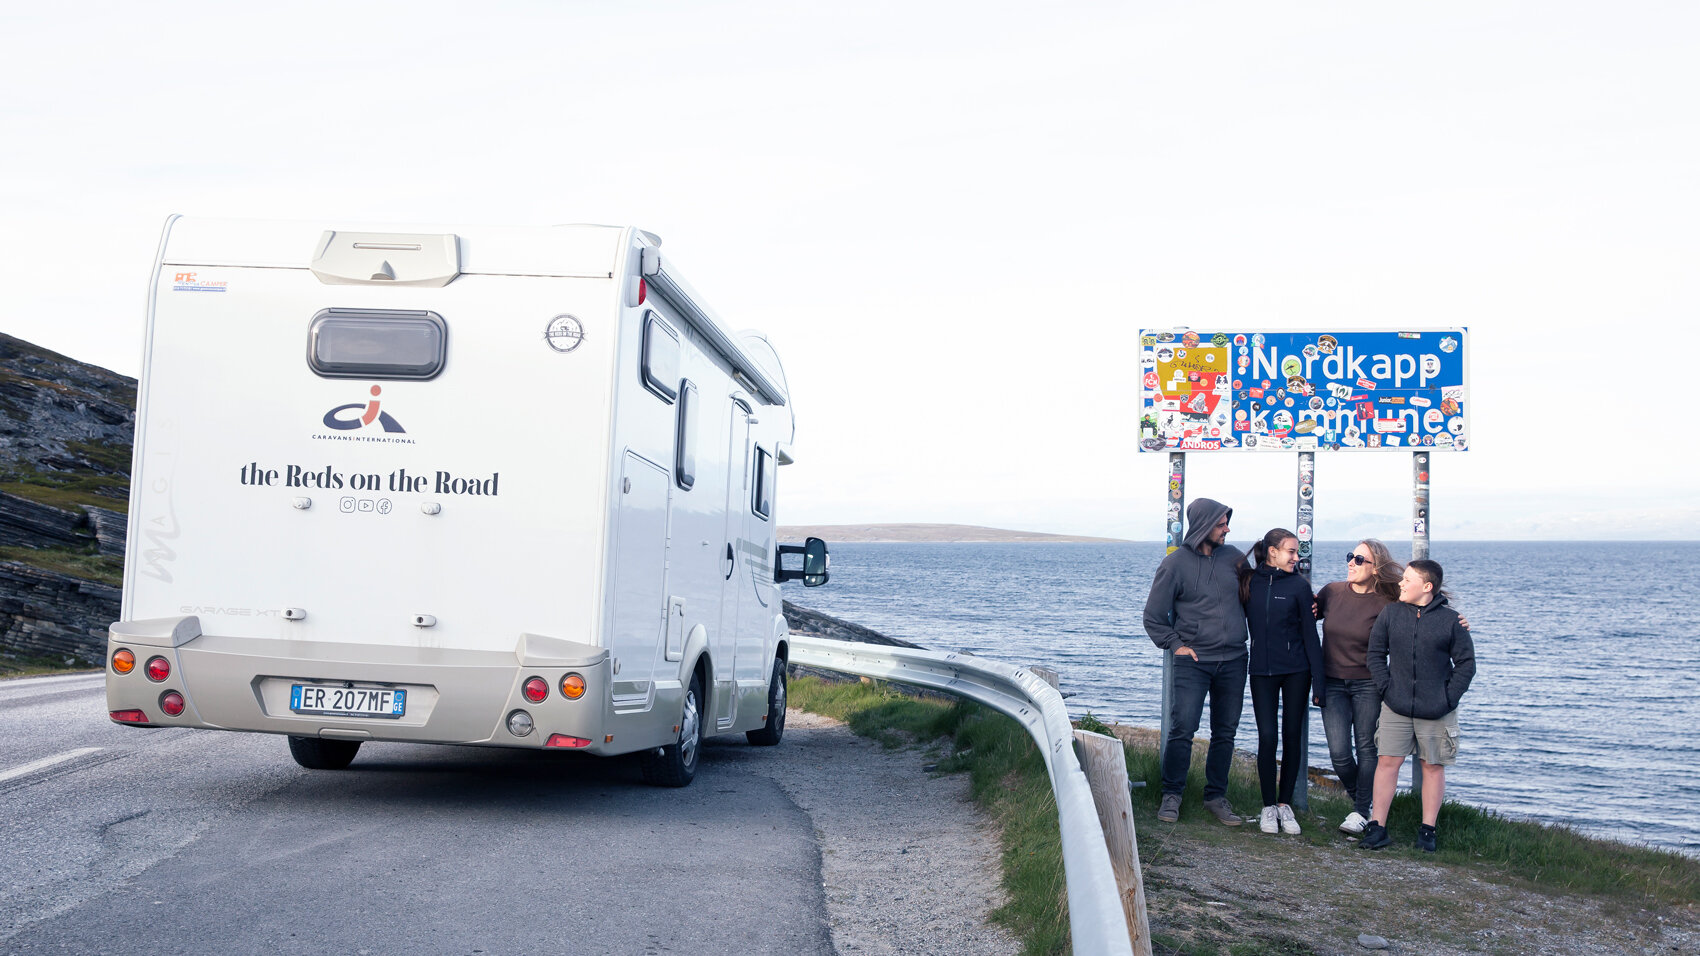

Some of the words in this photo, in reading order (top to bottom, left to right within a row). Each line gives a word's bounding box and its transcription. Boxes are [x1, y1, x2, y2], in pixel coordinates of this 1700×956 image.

[1252, 346, 1441, 387] Nordkapp
[1181, 441, 1220, 450] ANDROS
[240, 462, 279, 487] the
[285, 464, 344, 491] Reds
[350, 472, 380, 492] on
[388, 468, 428, 494] the
[434, 471, 499, 496] Road
[180, 605, 252, 616] GARAGE
[256, 608, 281, 617] XT
[303, 688, 326, 709] ER
[332, 690, 391, 712] 207MF
[393, 702, 403, 712] GE
